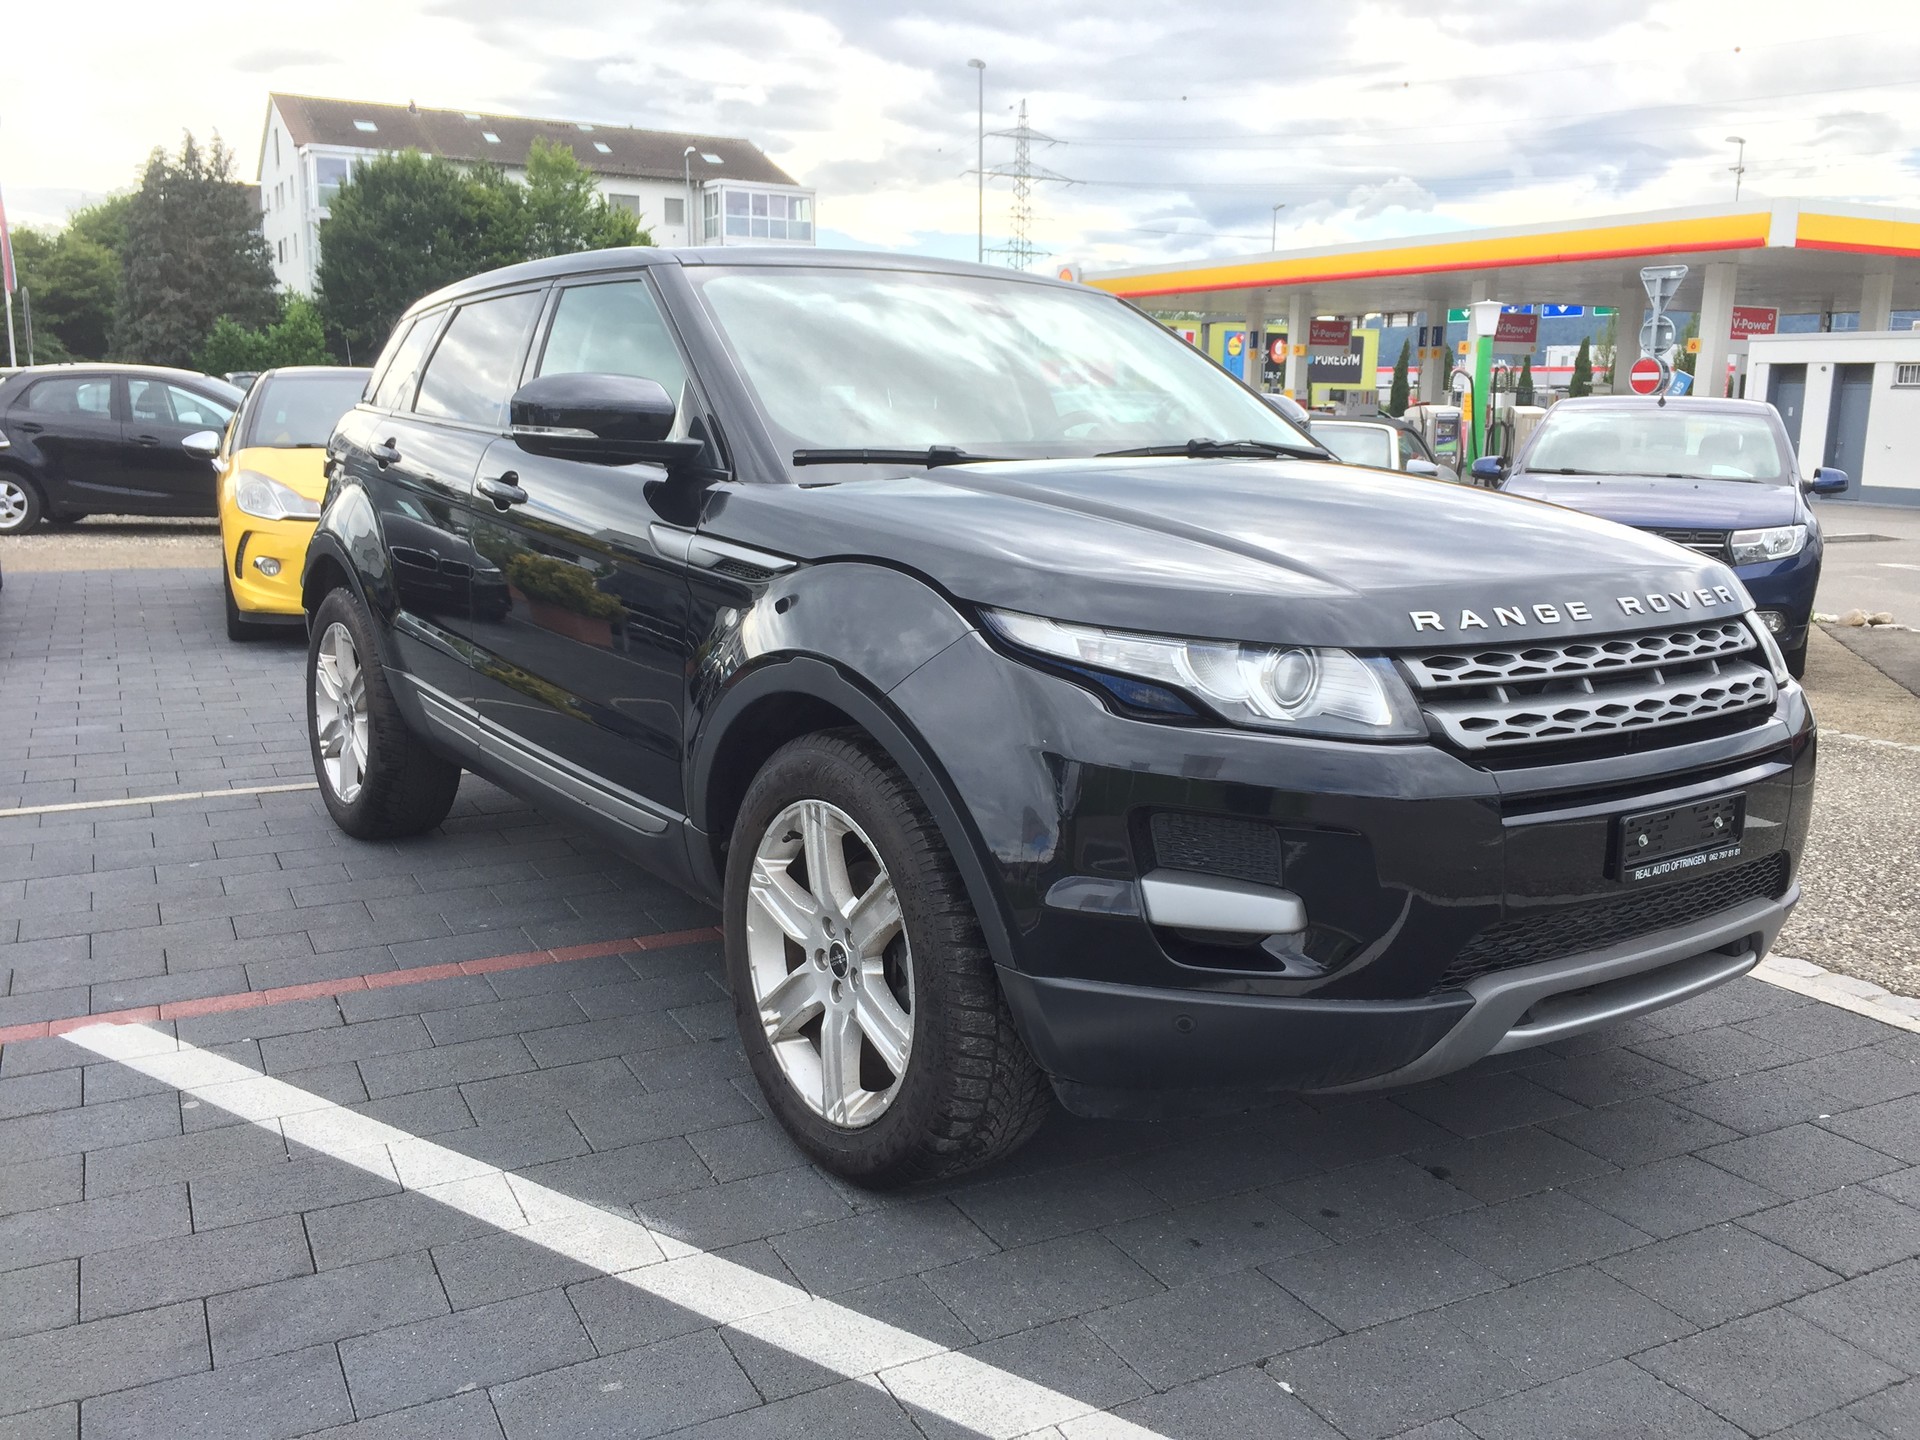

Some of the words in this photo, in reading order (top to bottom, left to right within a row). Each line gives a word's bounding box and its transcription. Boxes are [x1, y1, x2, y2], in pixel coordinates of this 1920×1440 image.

[1733, 317, 1771, 330] V-Power
[1312, 328, 1345, 338] V-Power
[1315, 354, 1360, 366] PUREGYM
[1450, 456, 1456, 464] 3
[1408, 601, 1593, 632] RANGE
[1616, 585, 1736, 615] ROVER
[1635, 870, 1652, 880] REAL
[1652, 863, 1670, 876] AUTO
[1671, 854, 1707, 870] OFTRINGEN
